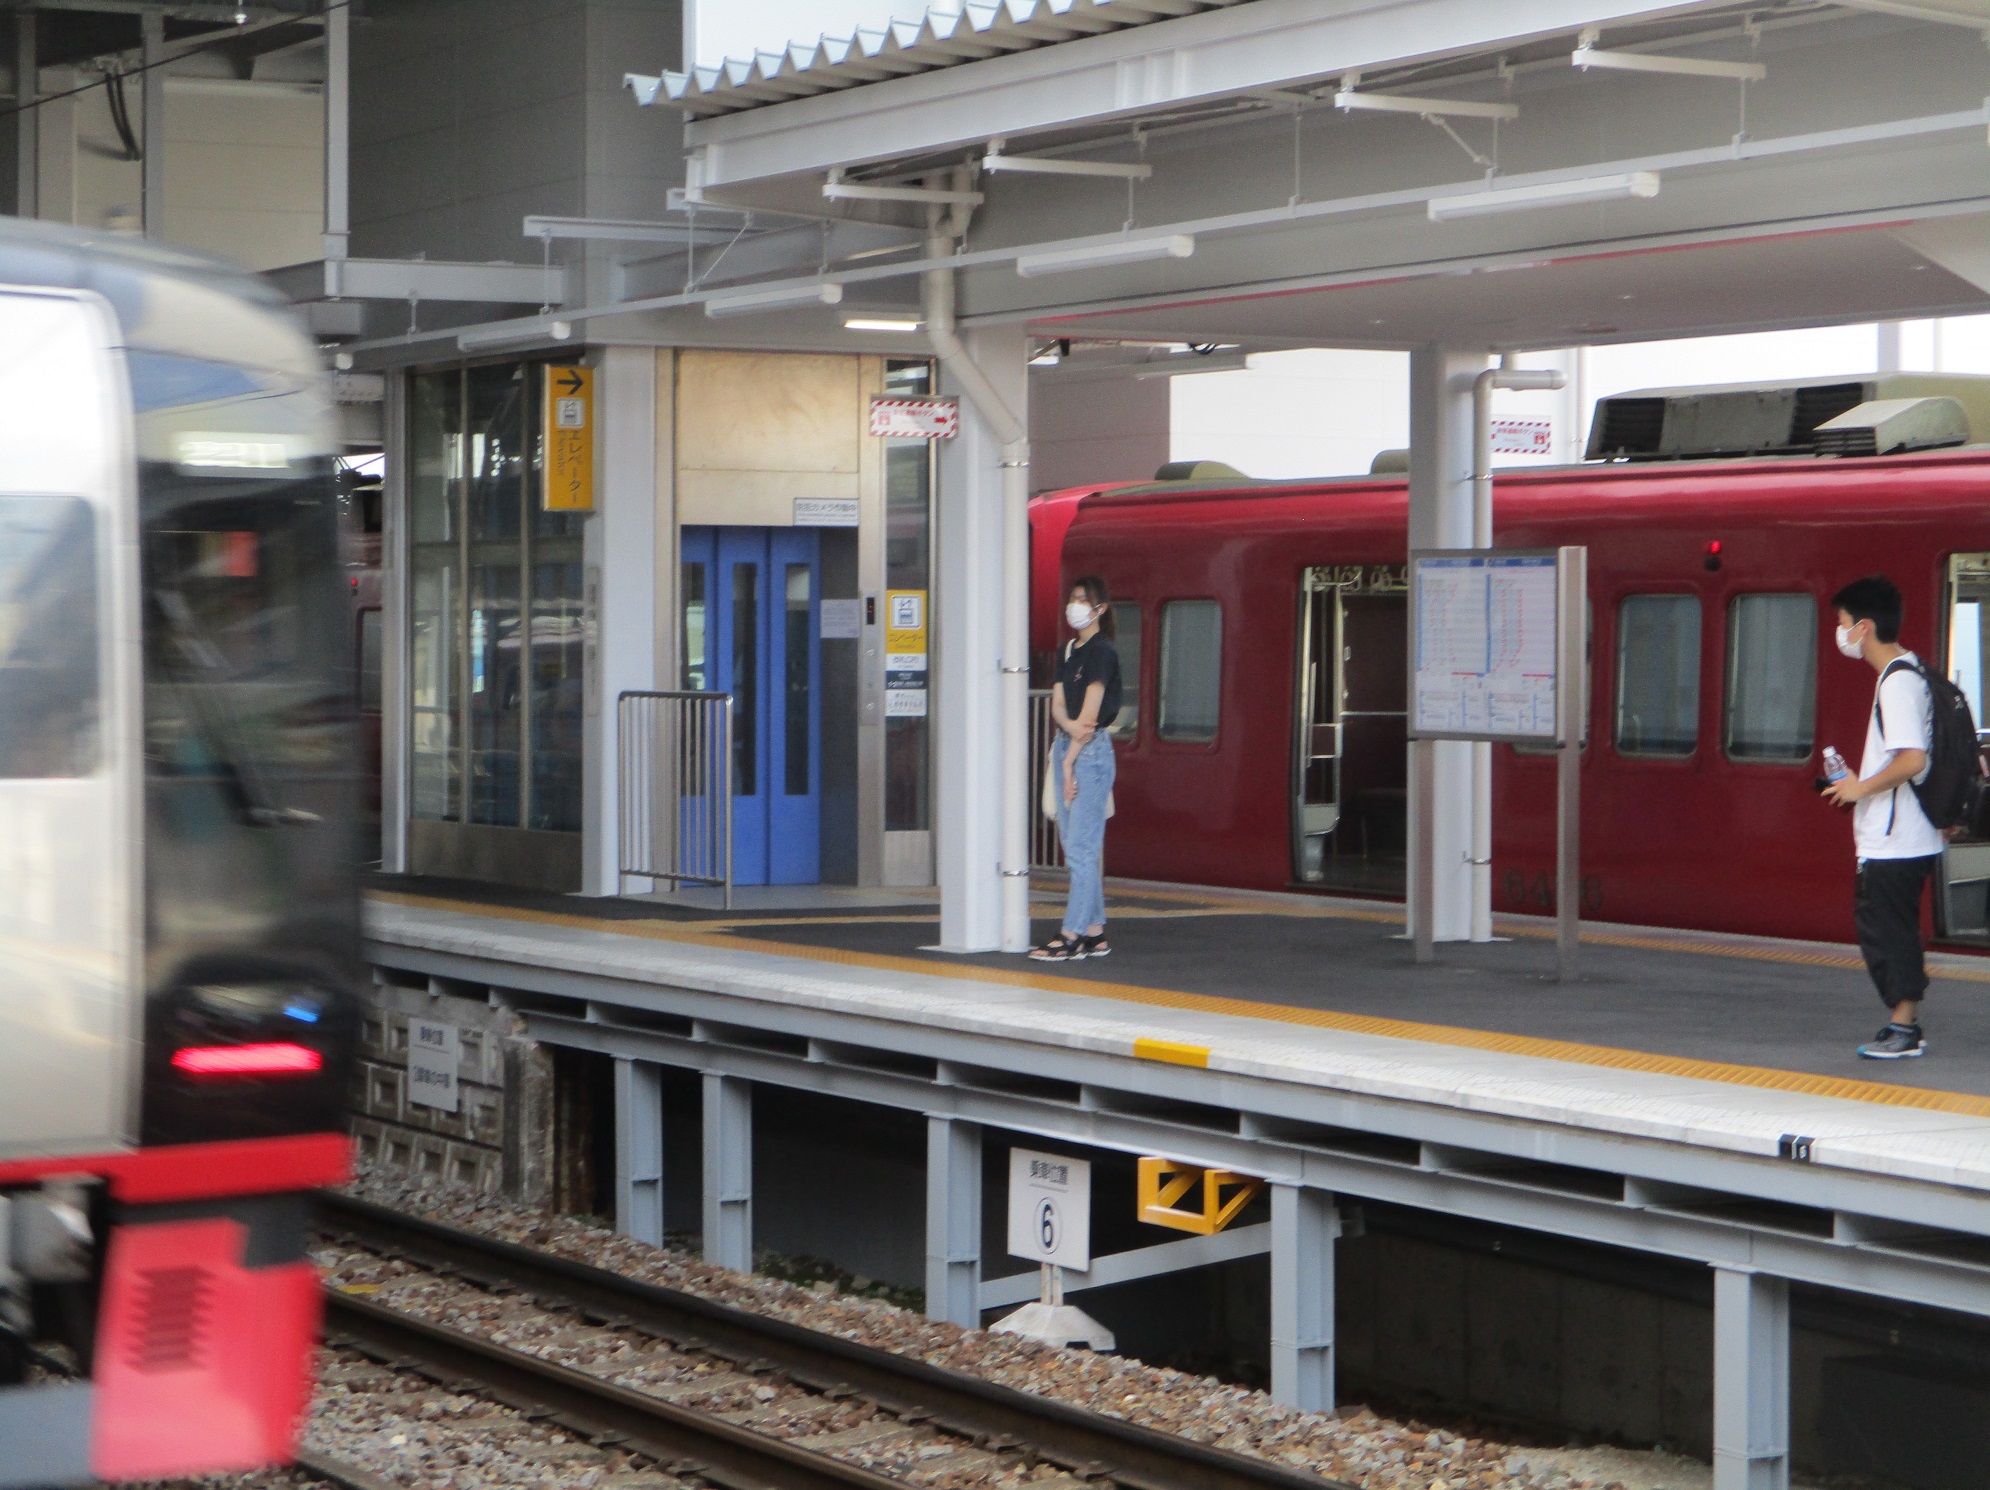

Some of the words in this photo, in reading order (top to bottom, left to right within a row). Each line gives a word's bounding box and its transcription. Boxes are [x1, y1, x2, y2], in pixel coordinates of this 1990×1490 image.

[568, 429, 583, 504] エレベーター
[1042, 1203, 1054, 1249] 6
